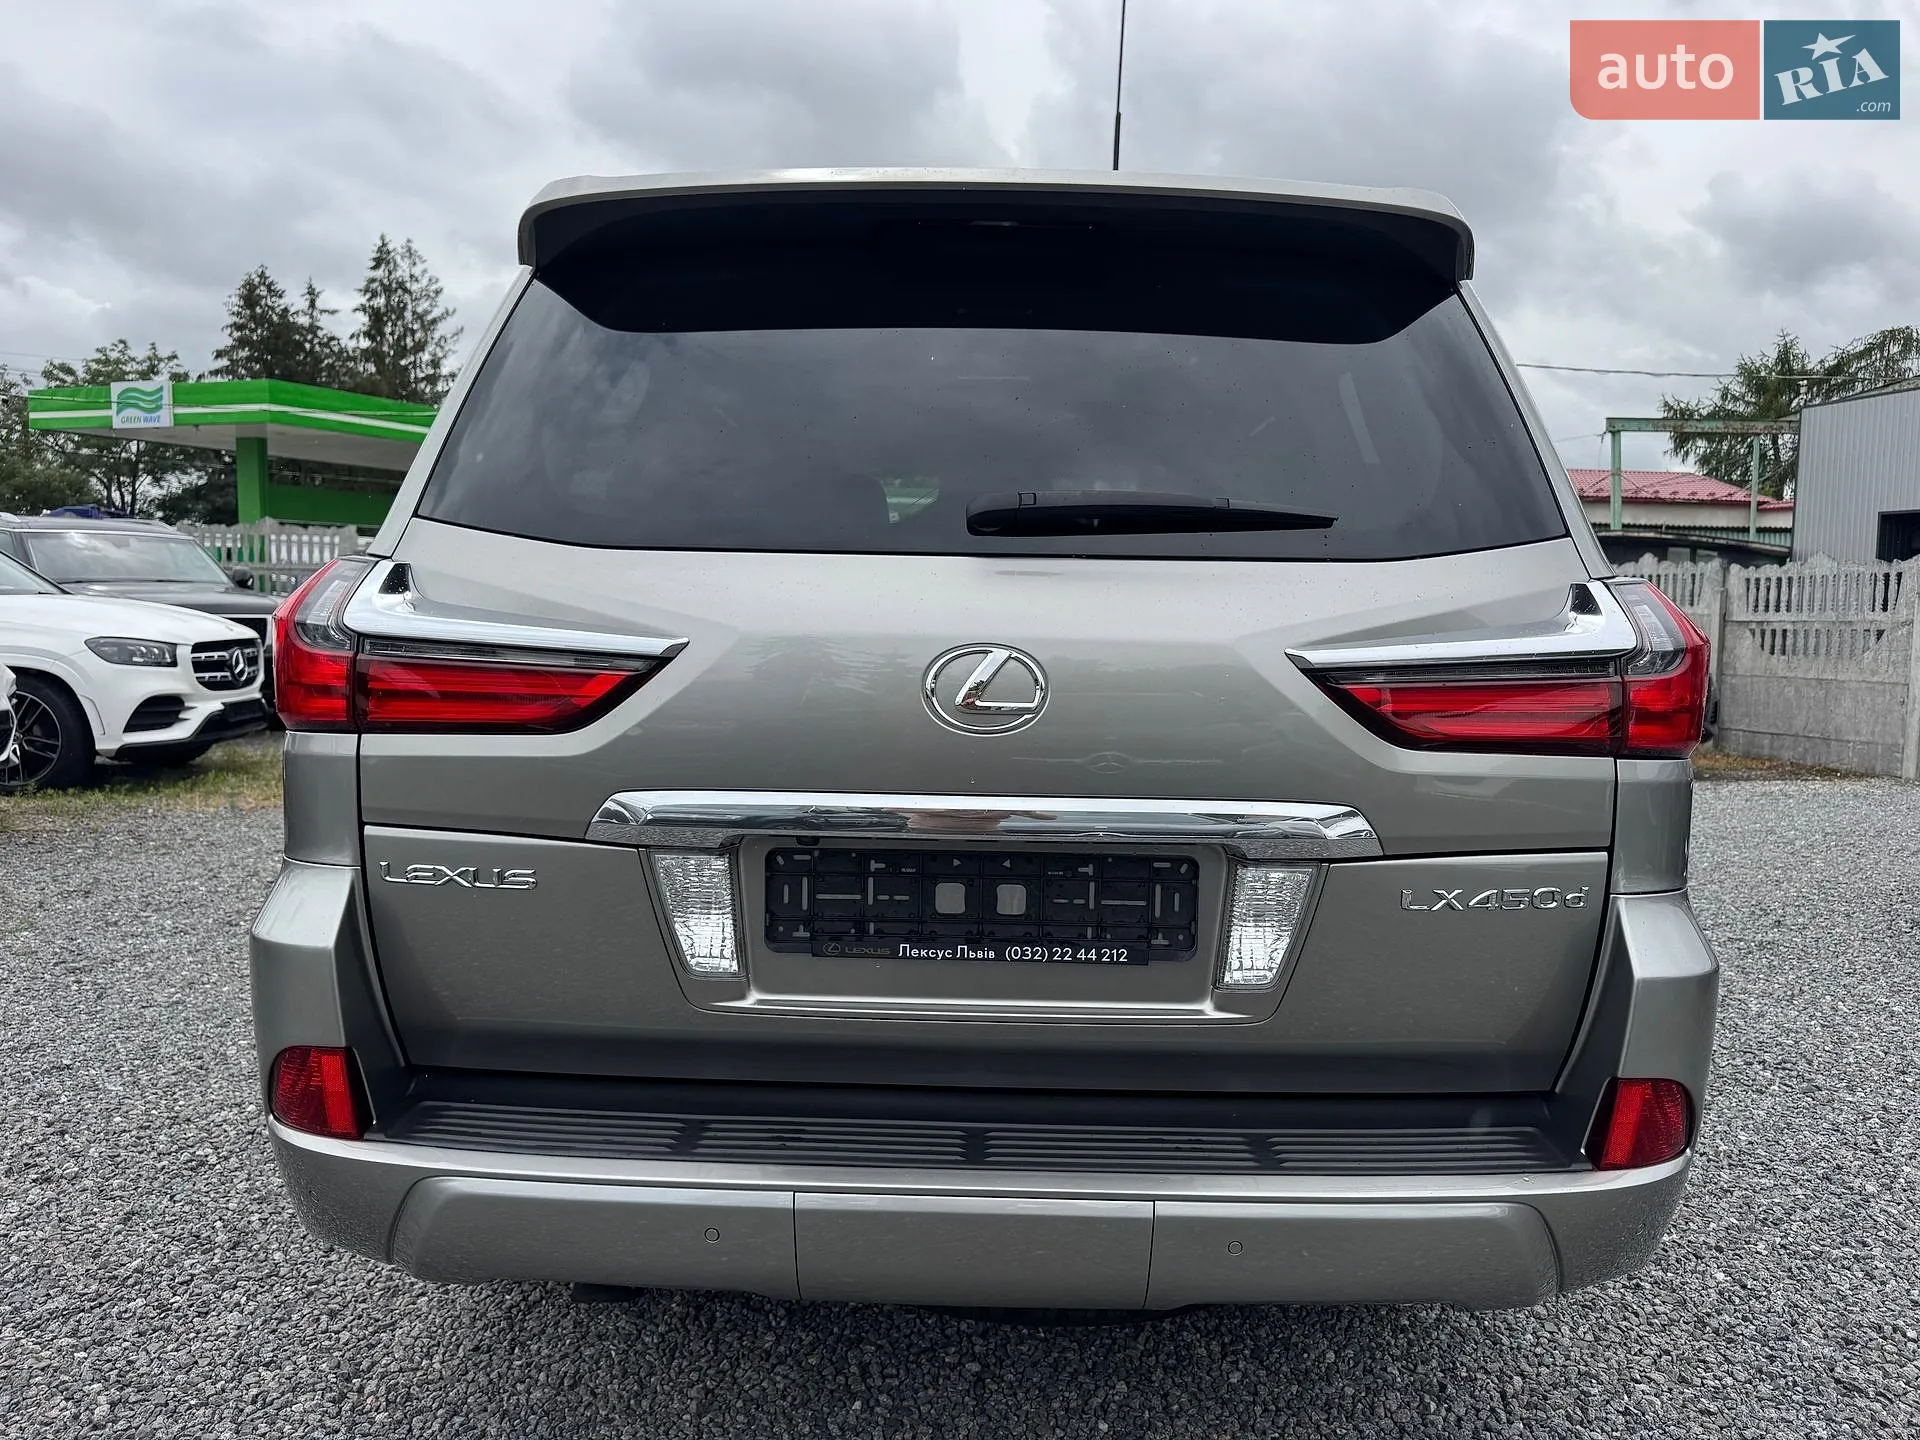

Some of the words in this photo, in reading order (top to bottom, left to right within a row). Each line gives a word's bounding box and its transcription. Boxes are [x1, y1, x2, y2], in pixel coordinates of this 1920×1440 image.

[120, 415, 141, 425] GREEN
[142, 415, 161, 424] WAVE
[379, 861, 538, 890] LEXUS
[1400, 886, 1590, 912] LX450d
[844, 946, 890, 955] LEXUS
[898, 943, 953, 960] Лексус
[956, 945, 995, 959] Львів
[1005, 946, 1049, 962] (032)
[1052, 947, 1073, 961] 22
[1076, 948, 1097, 961] 44
[1101, 948, 1128, 962] 212
